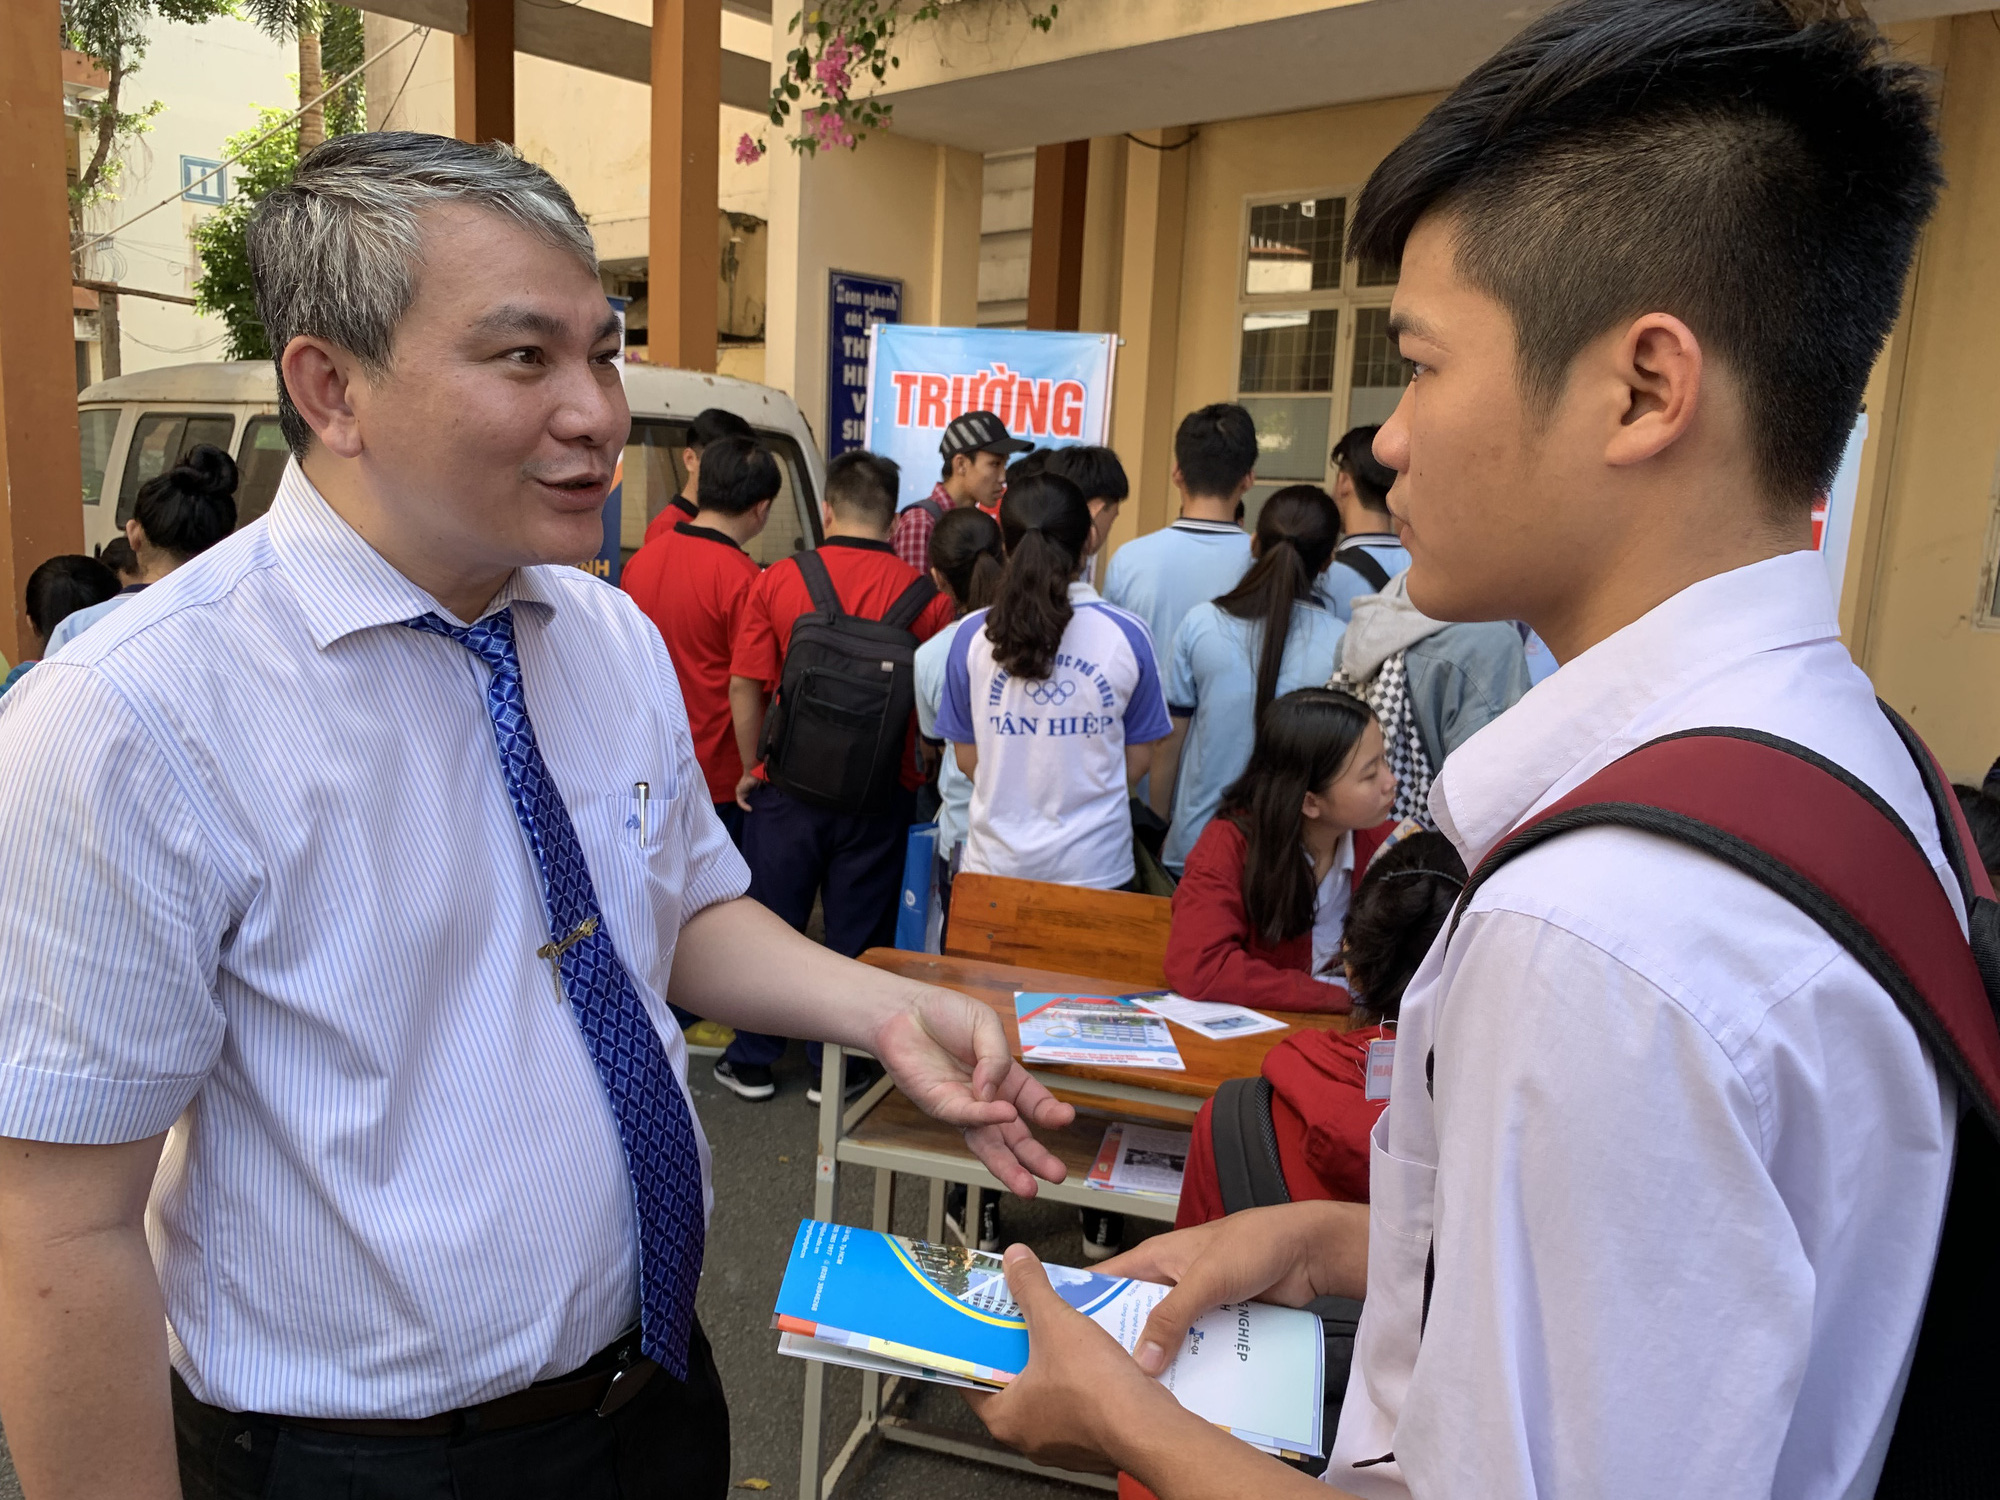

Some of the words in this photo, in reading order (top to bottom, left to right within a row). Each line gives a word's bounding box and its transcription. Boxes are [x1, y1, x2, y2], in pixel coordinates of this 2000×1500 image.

[186, 164, 222, 198] H
[892, 363, 1085, 438] TRƯỜNG
[990, 711, 1039, 735] TÂN
[1047, 711, 1114, 738] HIỆP
[1234, 1308, 1251, 1362] NGHIỆP
